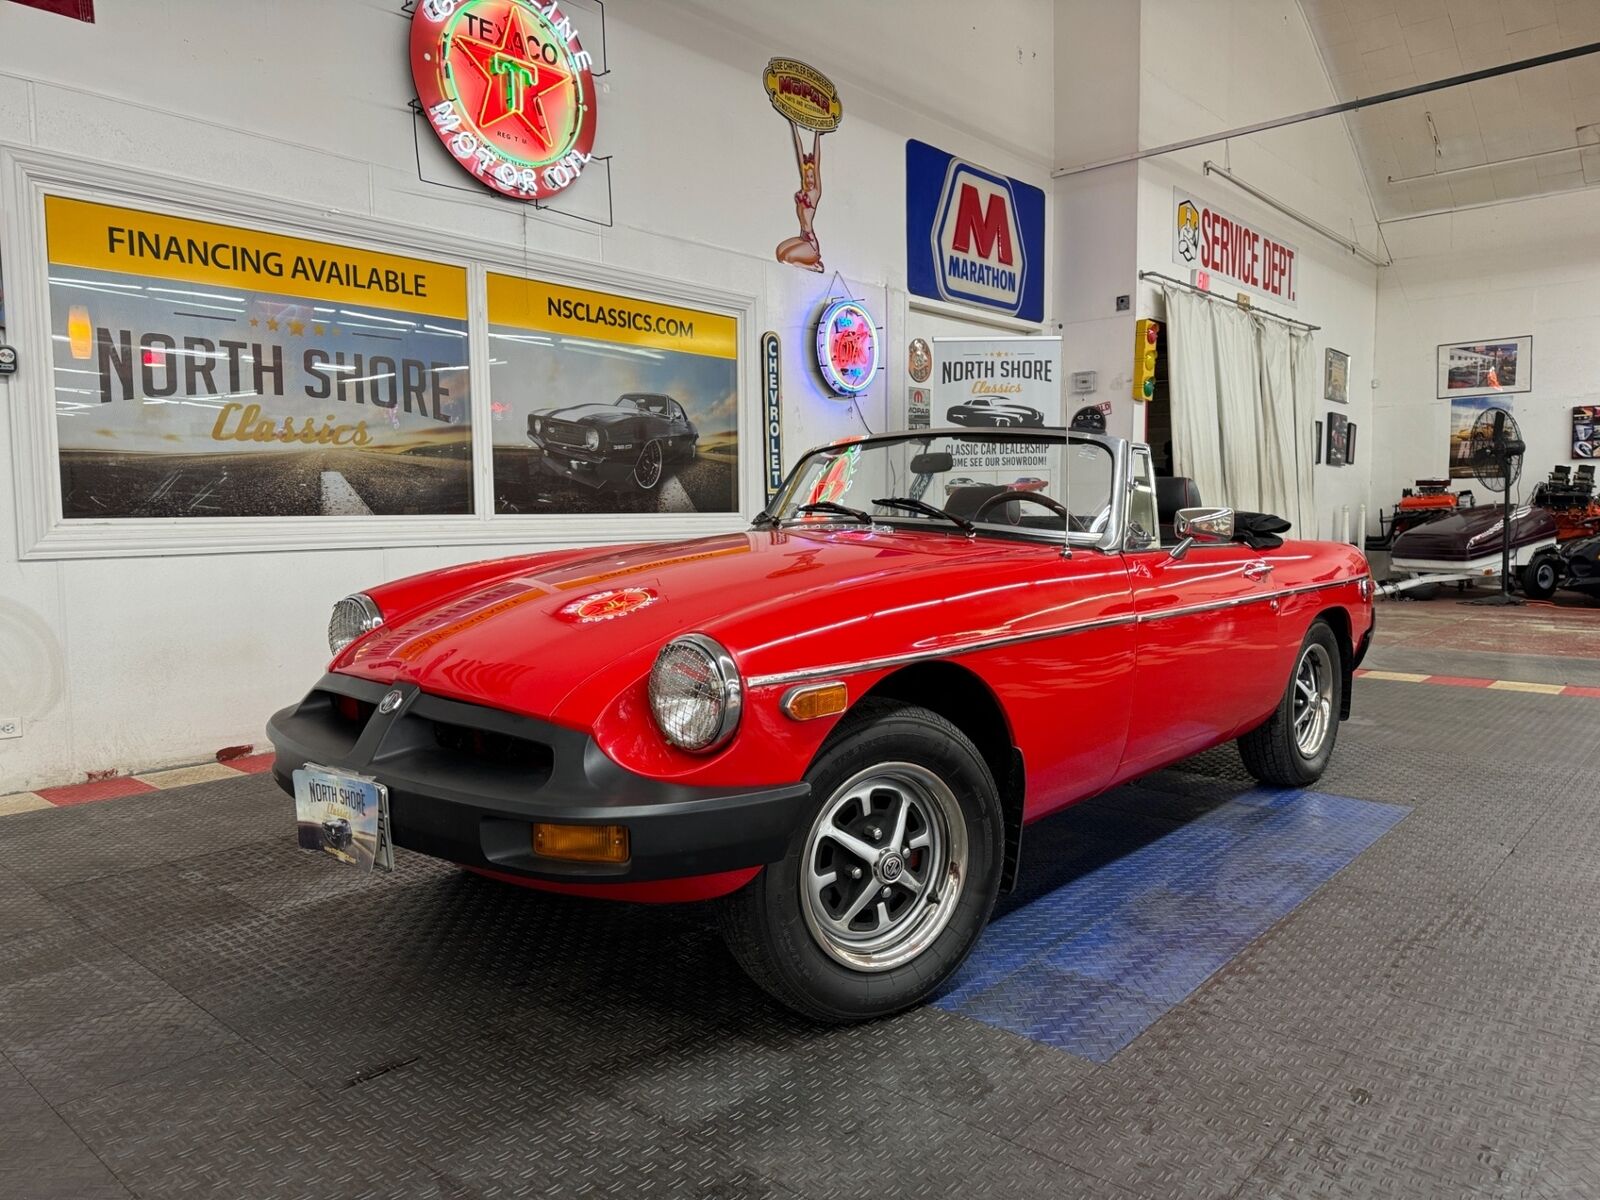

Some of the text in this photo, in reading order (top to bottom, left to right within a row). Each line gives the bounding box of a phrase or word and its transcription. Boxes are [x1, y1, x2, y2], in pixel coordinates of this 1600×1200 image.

[463, 12, 558, 66] TEXACO
[430, 100, 537, 196] MOTOR
[952, 182, 1014, 267] M
[107, 226, 428, 298] FINANCING AVAILABLE
[948, 255, 1016, 293] MARATHON
[1201, 208, 1296, 301] SERVICE DEPT.
[547, 296, 694, 339] NSCLASSICS.COM
[96, 327, 453, 424] NORTH SHORE
[942, 360, 1053, 384] NORTH SHORE
[971, 380, 1023, 394] Classics
[211, 402, 374, 446] Classics
[768, 341, 781, 486] CHEVROLET
[945, 442, 1050, 456] CLASSIC CAR DEALERSHIP
[970, 457, 983, 467] SEE
[985, 456, 1000, 467] OUR
[1001, 455, 1047, 467] SHOWROOM!
[309, 779, 366, 817] NORTH SHORE
